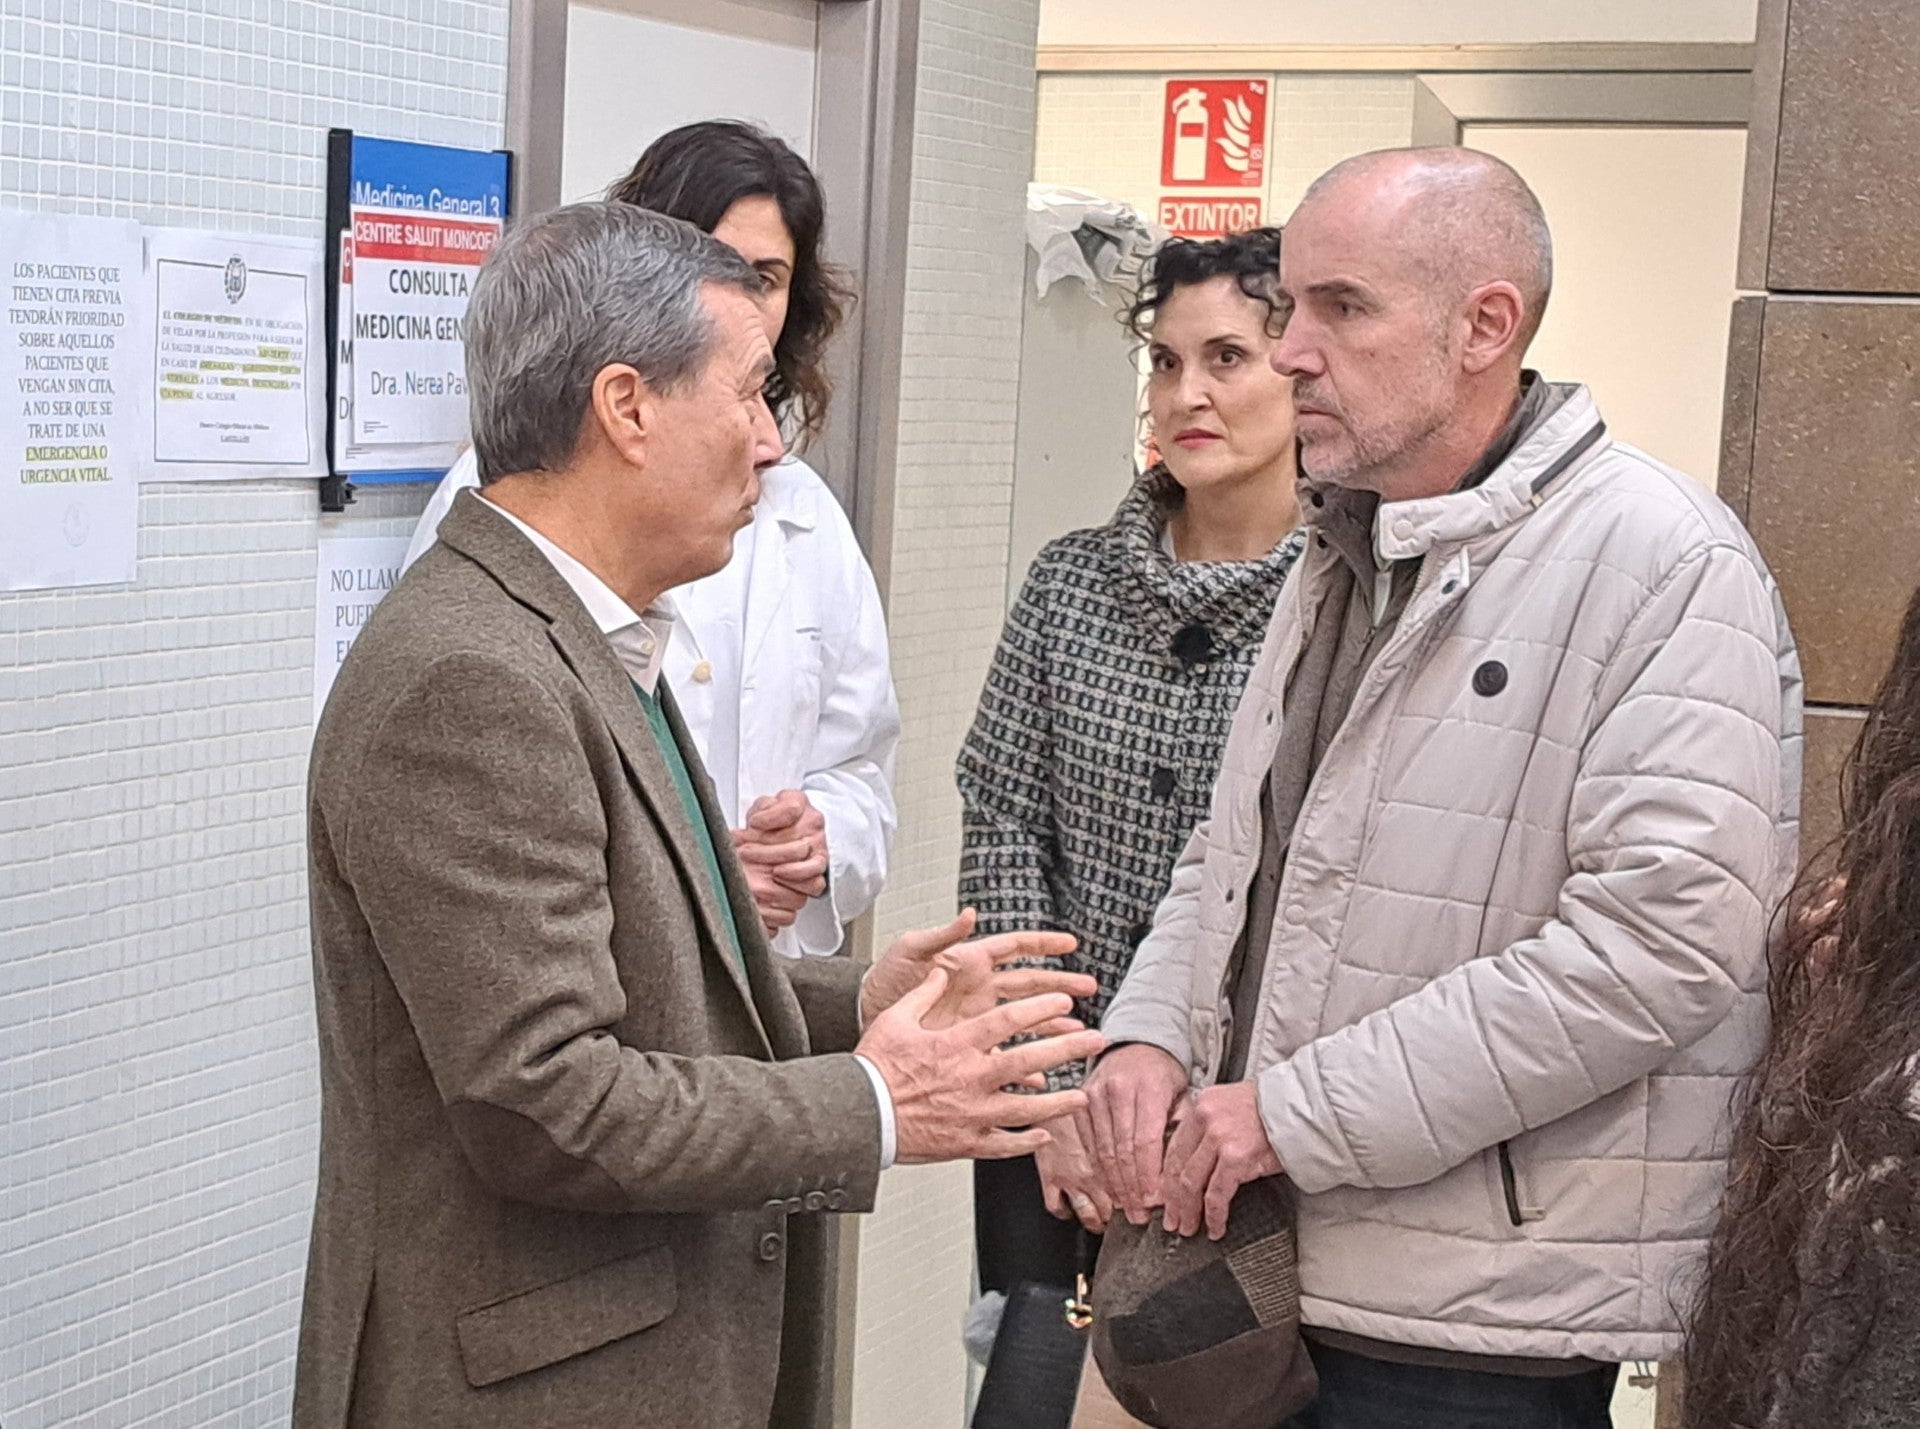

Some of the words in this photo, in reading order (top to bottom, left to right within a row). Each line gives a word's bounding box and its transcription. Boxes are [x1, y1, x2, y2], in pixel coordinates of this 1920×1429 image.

[355, 181, 425, 207] Medicina
[428, 188, 487, 215] General
[490, 195, 500, 217] 3
[1159, 202, 1258, 232] EXTINTOR
[355, 220, 403, 244] CENTRE
[404, 224, 442, 248] SALUT
[13, 262, 34, 278] LOS
[37, 264, 96, 281] PACIENTES
[98, 266, 120, 285] QUE
[388, 268, 469, 297] CONSULTA
[12, 285, 53, 302] TIENEN
[55, 287, 80, 303] CITA
[82, 289, 122, 305] PREVIA
[8, 306, 63, 325] TENDRÁN
[65, 310, 125, 327] PRIORIDAD
[355, 313, 432, 341] MEDICINA
[18, 332, 55, 348] SOBRE
[57, 333, 115, 351] AQUELLOS
[25, 355, 84, 371] PACIENTES
[86, 356, 110, 373] QUE
[18, 378, 65, 393] VENGAN
[68, 378, 86, 393] SIN
[87, 378, 115, 396] CITA,
[371, 370, 401, 396] Dra.
[405, 371, 444, 396] Nerea
[23, 401, 31, 416] A
[33, 400, 50, 416] NO
[52, 400, 73, 416] SER
[74, 400, 98, 418] QUE
[99, 401, 113, 415] SE
[27, 423, 63, 438] TRATE
[65, 423, 80, 438] DE
[82, 423, 106, 438] UNA
[25, 445, 99, 461] EMERGENCIA
[99, 444, 108, 460] O
[20, 468, 79, 484] URGENCIA
[79, 467, 113, 482] VITAL.
[330, 569, 353, 592] NO
